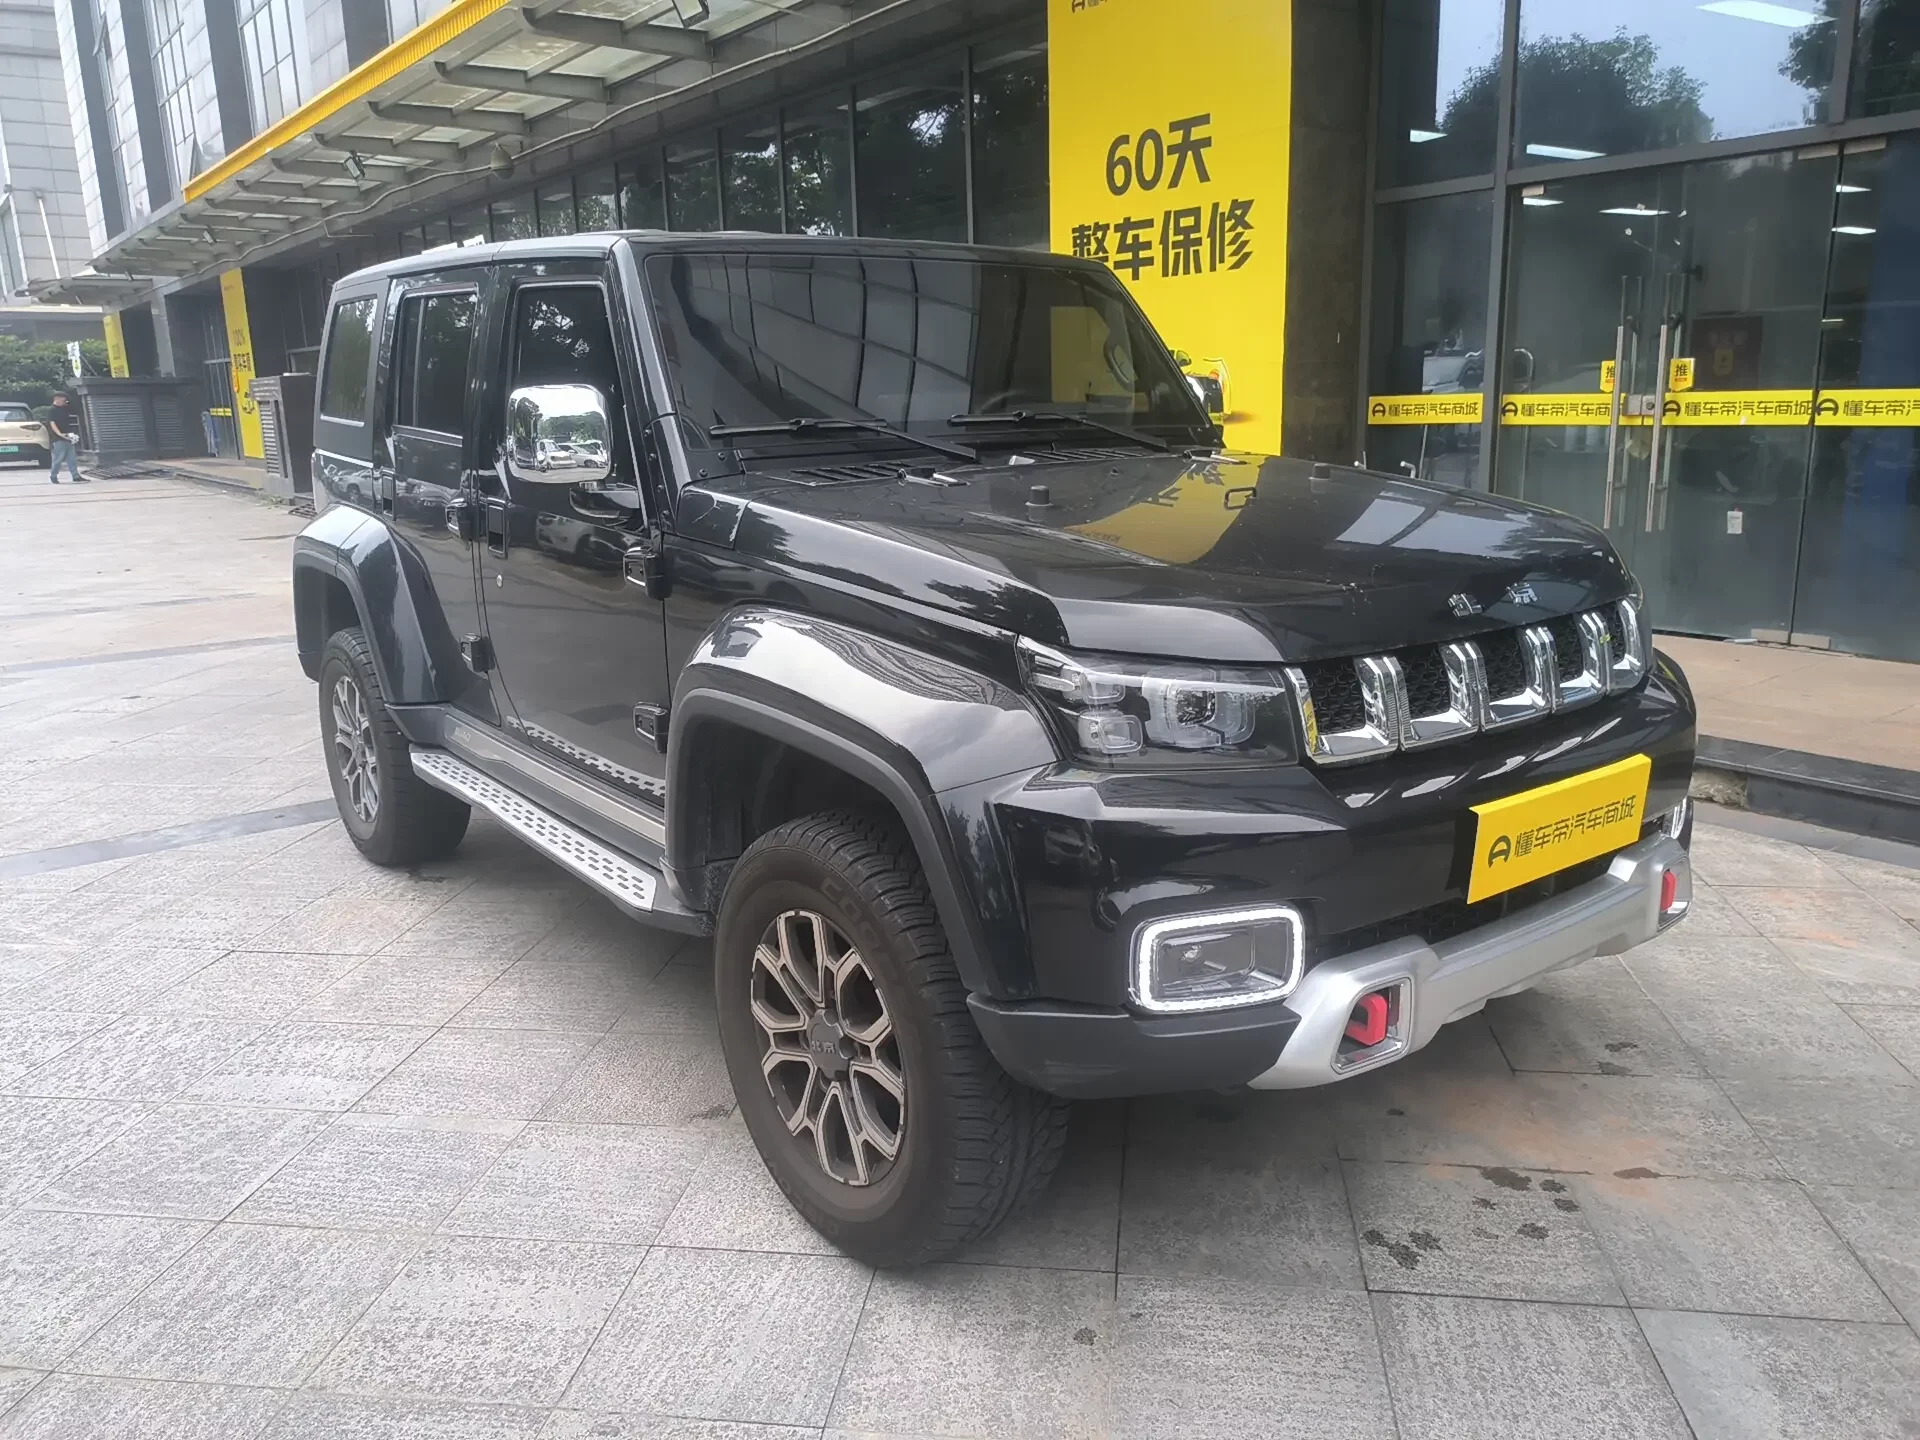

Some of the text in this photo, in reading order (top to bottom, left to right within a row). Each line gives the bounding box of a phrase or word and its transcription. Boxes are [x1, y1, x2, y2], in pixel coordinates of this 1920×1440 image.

[1106, 113, 1212, 197] 60天
[1071, 198, 1256, 282] 整车保修
[1675, 364, 1688, 377] 推
[1388, 401, 1479, 417] 懂车帝汽车商城
[1521, 402, 1612, 417] 懂车帝汽车商
[1684, 400, 1812, 417] 懂车帝汽车商城
[1514, 794, 1637, 857] 懂车帝汽车商城
